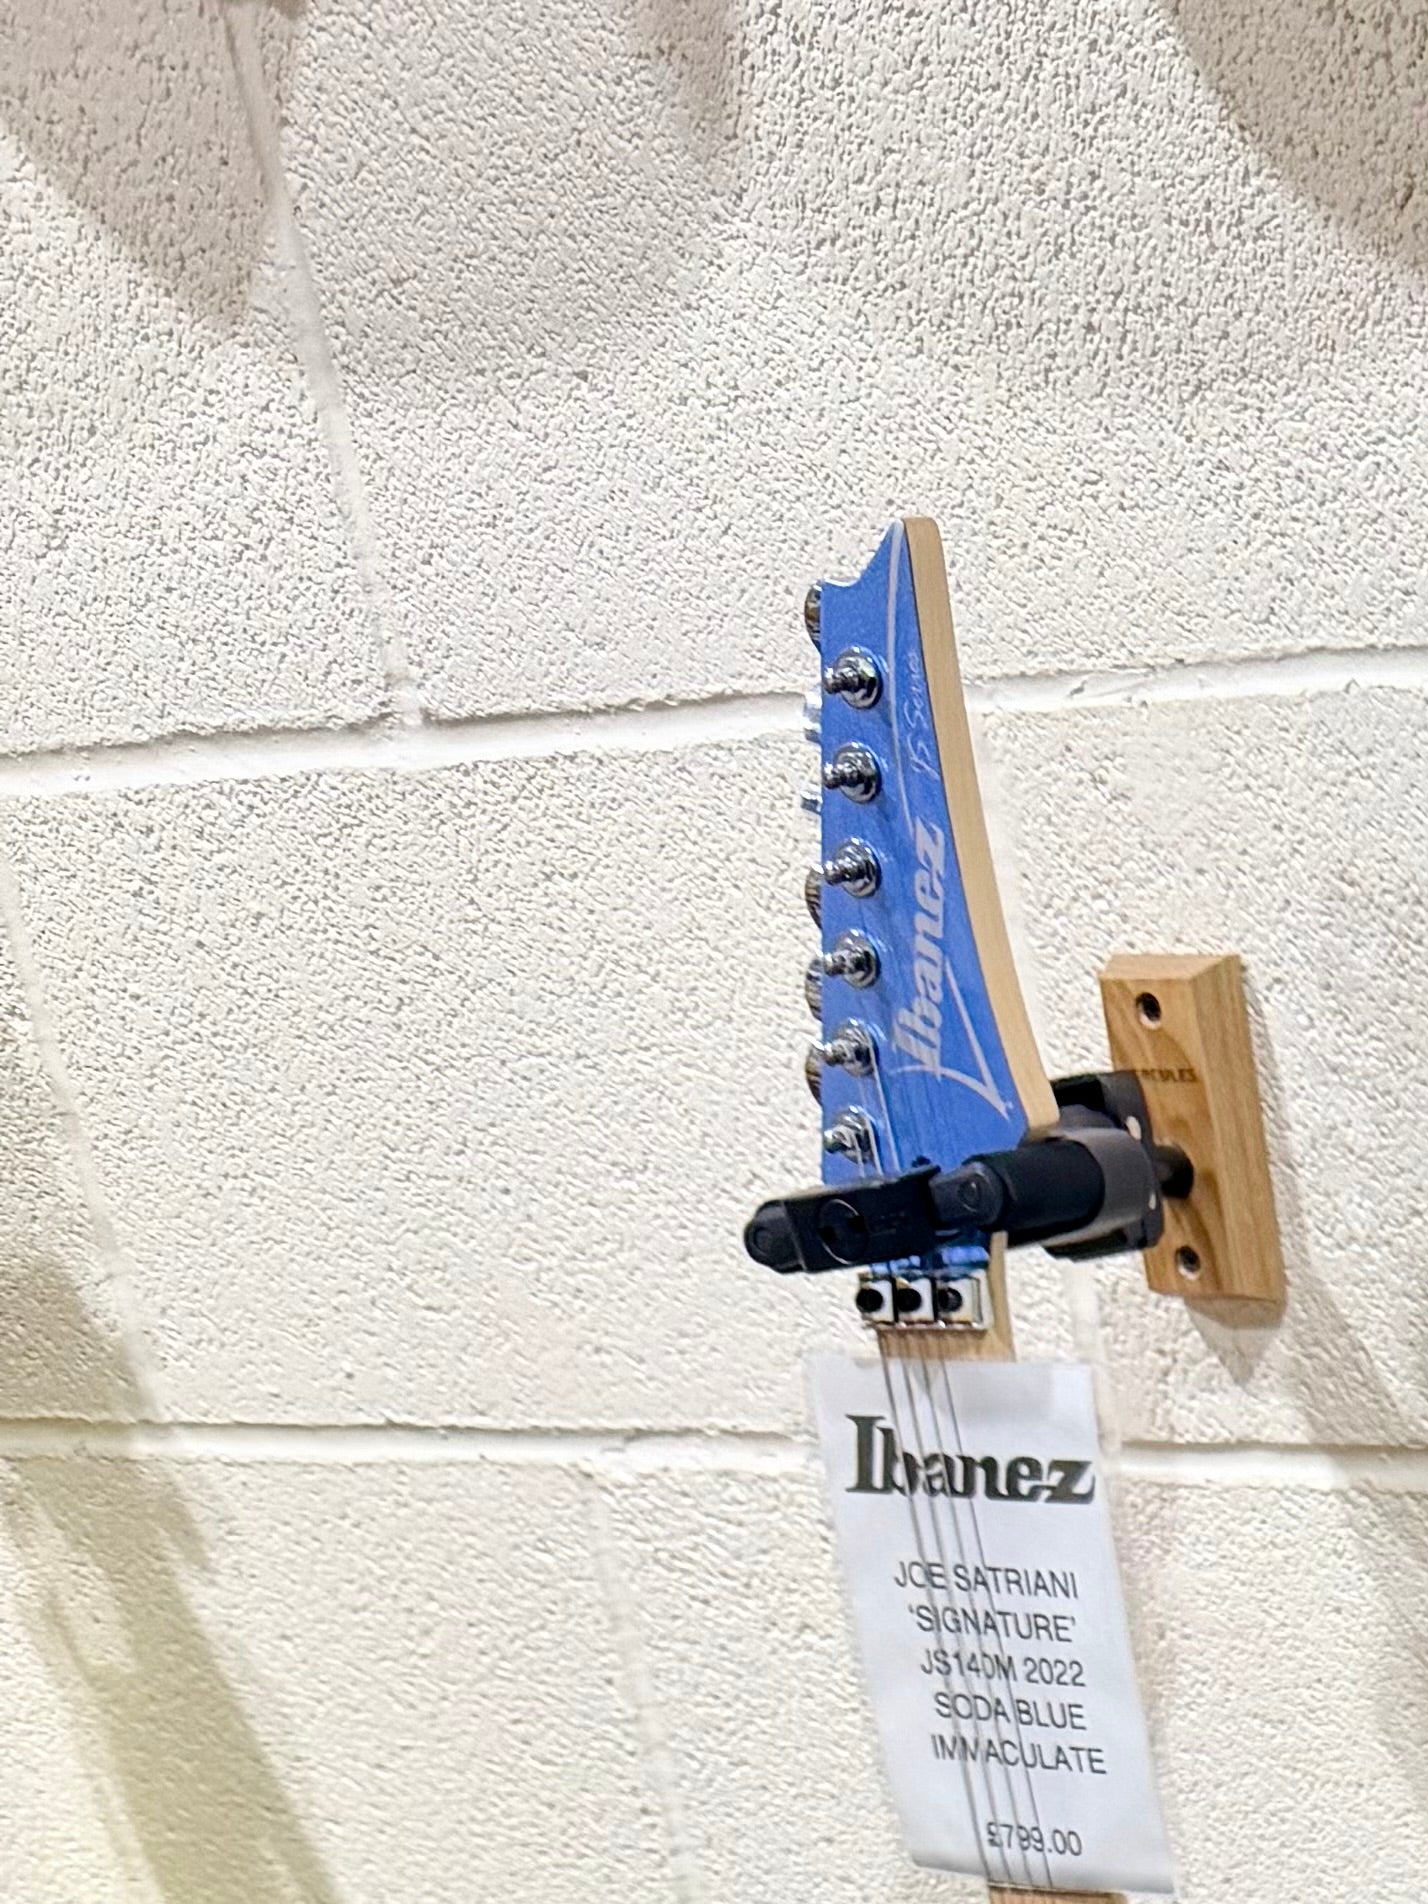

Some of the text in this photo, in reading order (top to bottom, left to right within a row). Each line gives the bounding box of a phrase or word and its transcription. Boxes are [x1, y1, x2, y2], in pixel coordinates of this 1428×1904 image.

[892, 816, 945, 1082] Ibanez
[846, 1414, 1096, 1505] Ibanez
[894, 1560, 1079, 1600] JOE SATRIANI
[920, 1649, 1086, 1687] JS140M 2022
[934, 1692, 1086, 1731] SODA BLUE
[932, 1734, 1107, 1776] IMMACULATE
[987, 1822, 1083, 1857] £799.00
